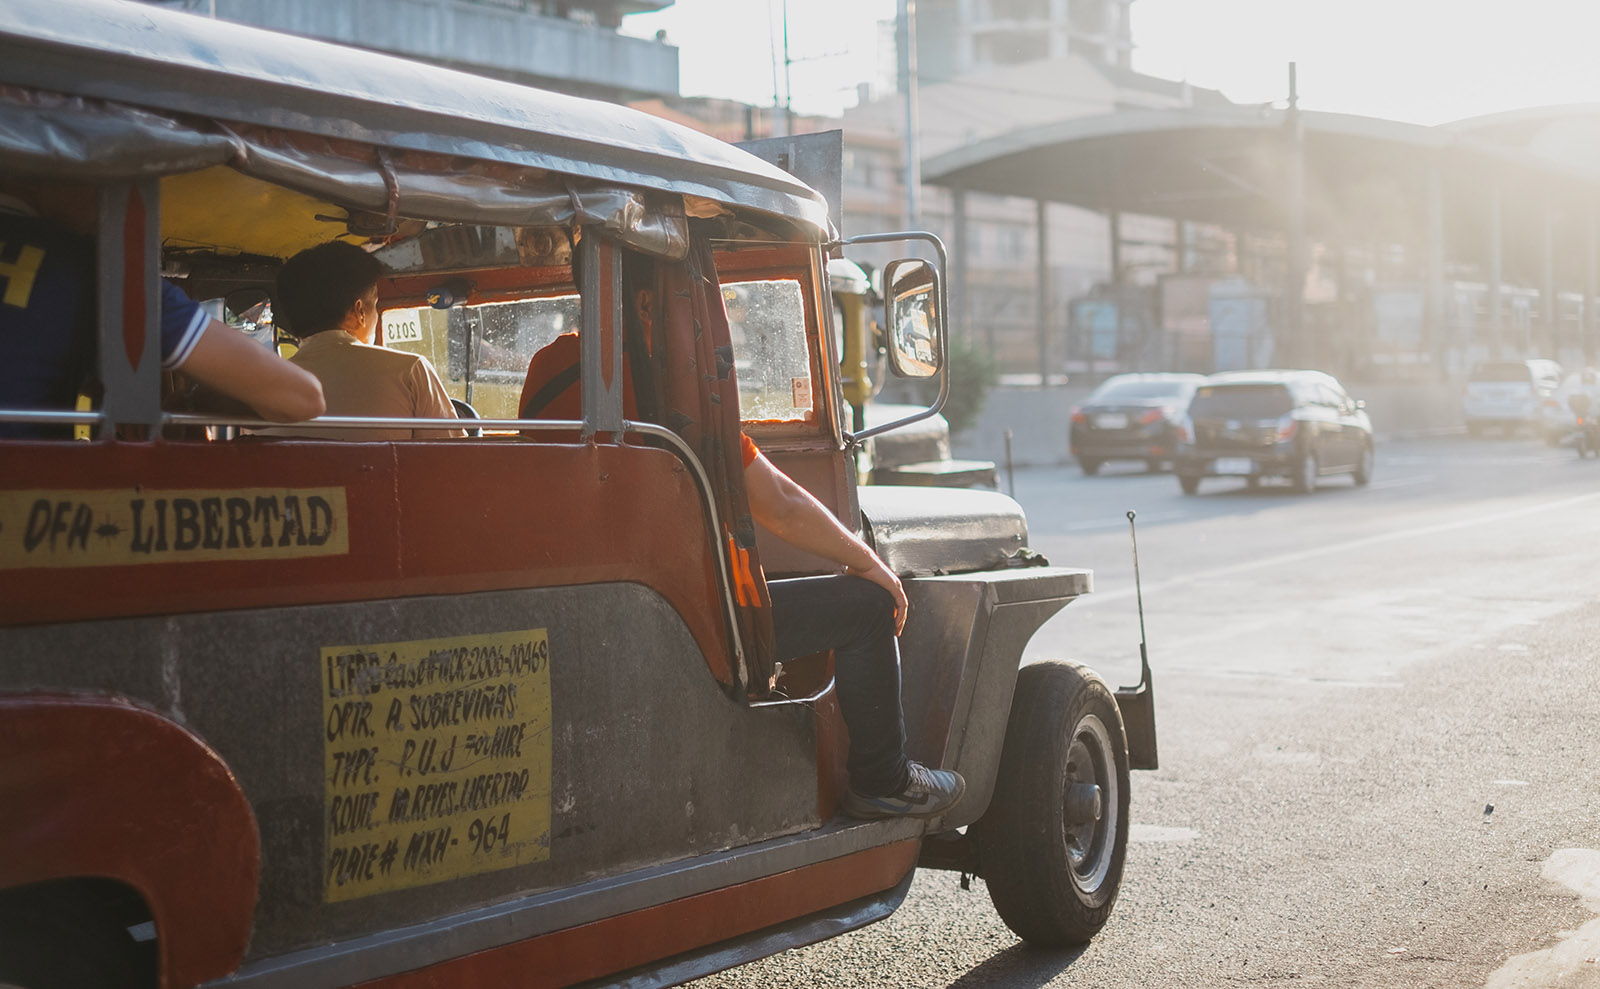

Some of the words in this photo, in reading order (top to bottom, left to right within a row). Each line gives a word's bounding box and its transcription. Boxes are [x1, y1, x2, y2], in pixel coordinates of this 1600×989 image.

[131, 495, 333, 553] LIBERTAD
[410, 683, 517, 731] SOBREVIÑAS
[468, 813, 511, 856] 964
